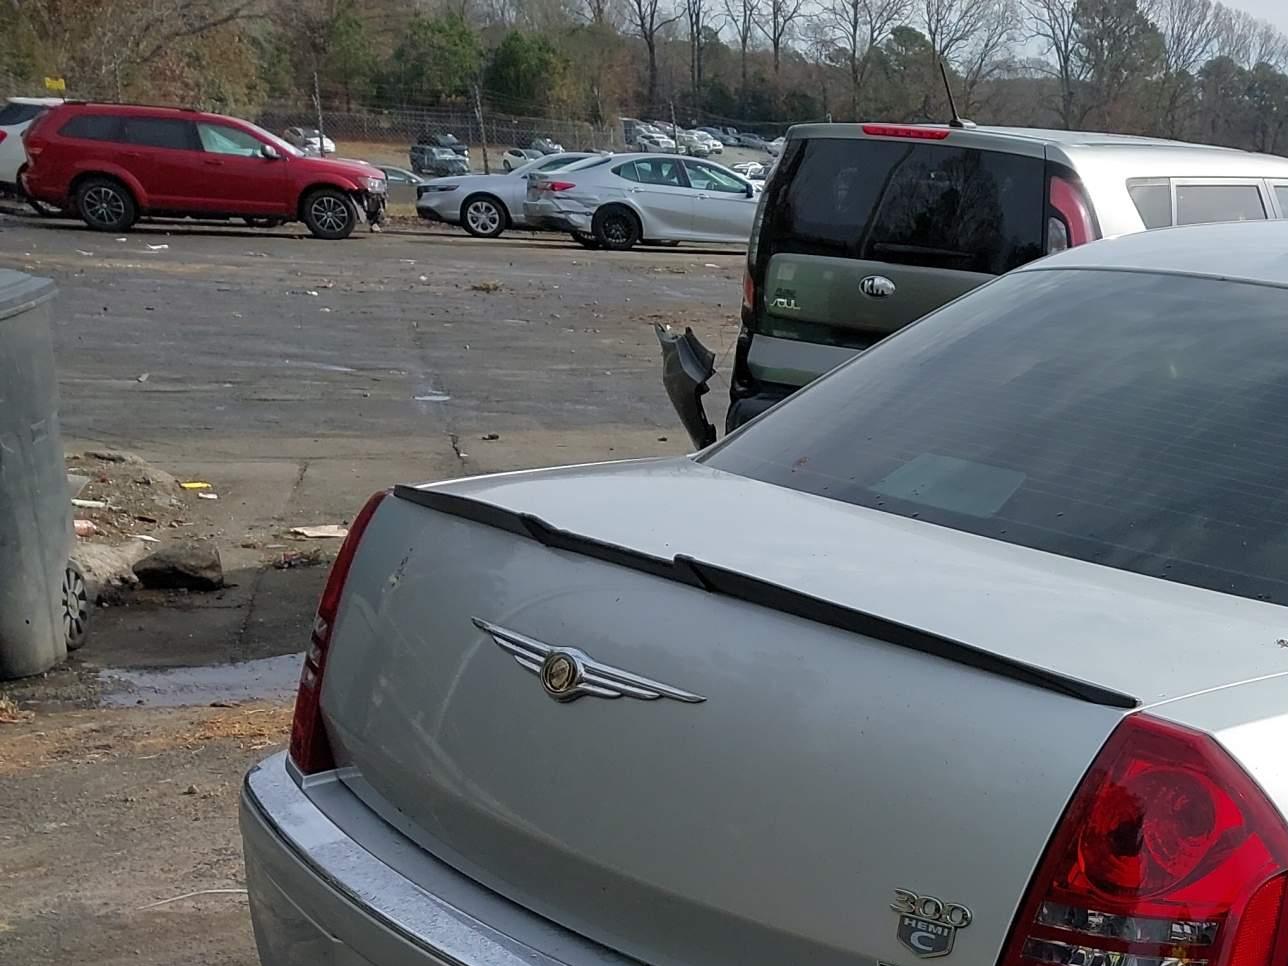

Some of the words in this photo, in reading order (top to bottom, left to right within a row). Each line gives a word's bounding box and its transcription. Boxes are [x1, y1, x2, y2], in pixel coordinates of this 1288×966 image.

[889, 887, 973, 928] 300
[903, 917, 950, 937] HEMI
[910, 930, 936, 951] C
